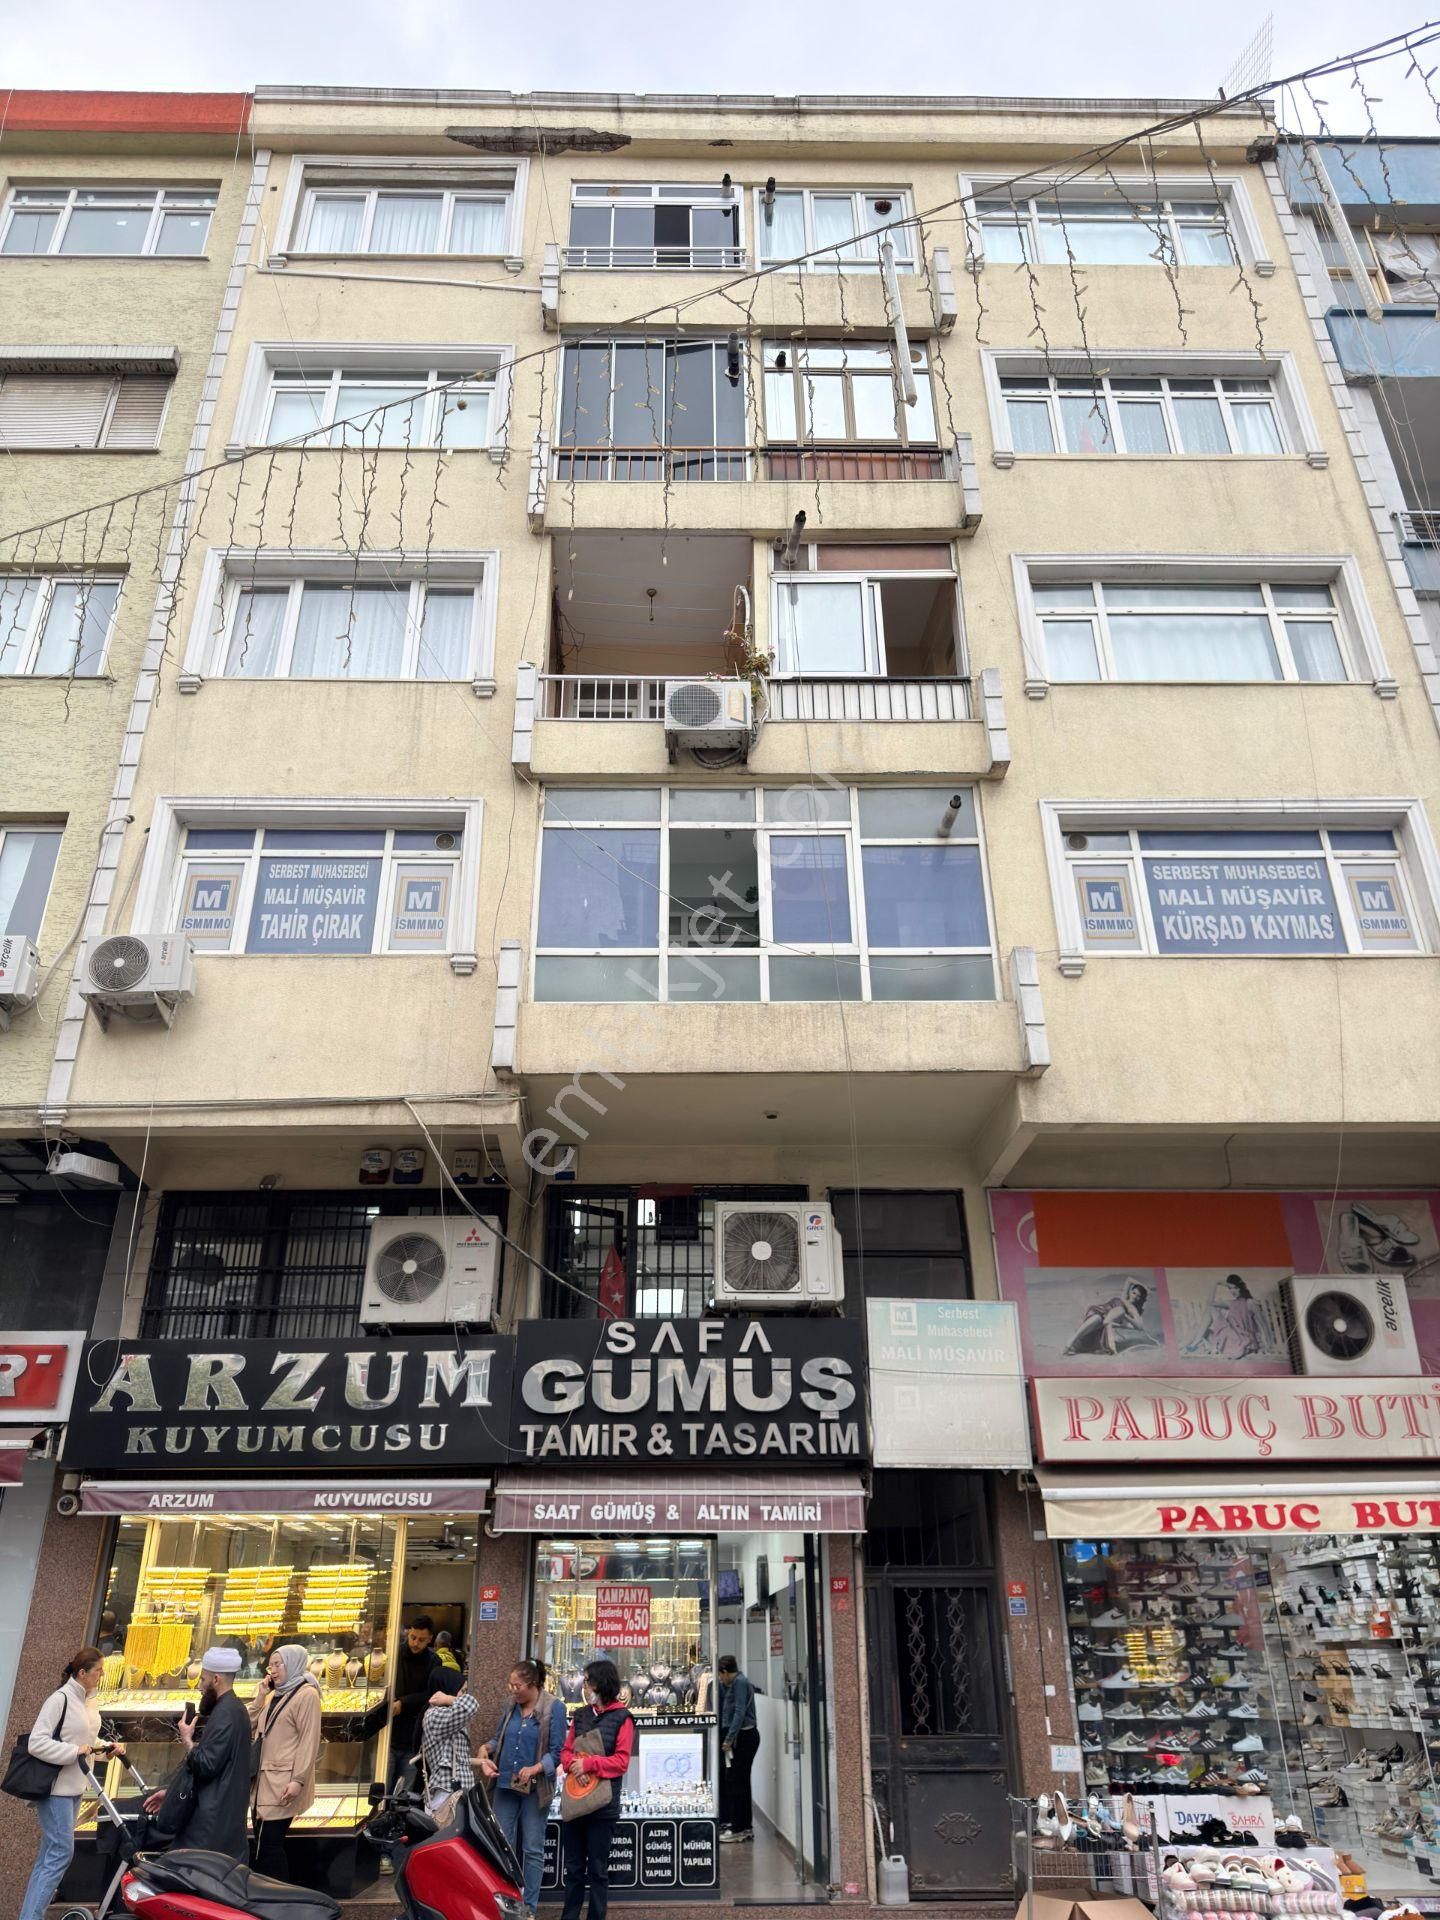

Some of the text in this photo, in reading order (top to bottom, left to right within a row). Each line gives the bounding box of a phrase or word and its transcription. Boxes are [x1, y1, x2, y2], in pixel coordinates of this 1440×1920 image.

[270, 861, 369, 879] SERBEST MUHASEBECİ
[1153, 861, 1321, 881] SERBEST MUHASEBECİ
[264, 884, 365, 909] MALİ MÜŞAVİR
[1159, 884, 1325, 909] MALİ MÜŞAVİR
[260, 908, 363, 945] TAHİR ÇIRAK
[1162, 911, 1246, 946] KÜRŞAD
[1, 938, 14, 968] arçelik
[937, 1306, 980, 1319] Serbest
[1376, 1280, 1398, 1331] arçelik
[927, 1324, 993, 1338] Muhasebeci
[881, 1344, 921, 1361] MALİ
[90, 1350, 496, 1412] ARZUM
[521, 1357, 856, 1420] GÜMÜŞ
[1058, 1394, 1276, 1456] PABUÇ
[124, 1423, 449, 1454] KUYUMCUSU
[646, 1423, 674, 1456] &
[148, 1492, 433, 1508] ARZUM KUYUMCUSU
[534, 1502, 822, 1524] SAAT GÜMÜŞ & ALTIN TAMİRİ
[1157, 1503, 1321, 1533] PABUÇ
[597, 1588, 649, 1604] KAMPANYA
[1012, 1584, 1022, 1594] 35
[624, 1608, 649, 1631] %50
[596, 1634, 648, 1646] İNDİRİM
[673, 1716, 718, 1725] YAPILIR
[611, 1837, 632, 1845] URDA
[645, 1842, 672, 1852] GÜMÜŞ
[683, 1841, 711, 1850] MÜHÜR
[646, 1855, 671, 1864] TAMİRİ
[683, 1858, 712, 1866] YAPILIR
[645, 1869, 672, 1878] YAPILIR
